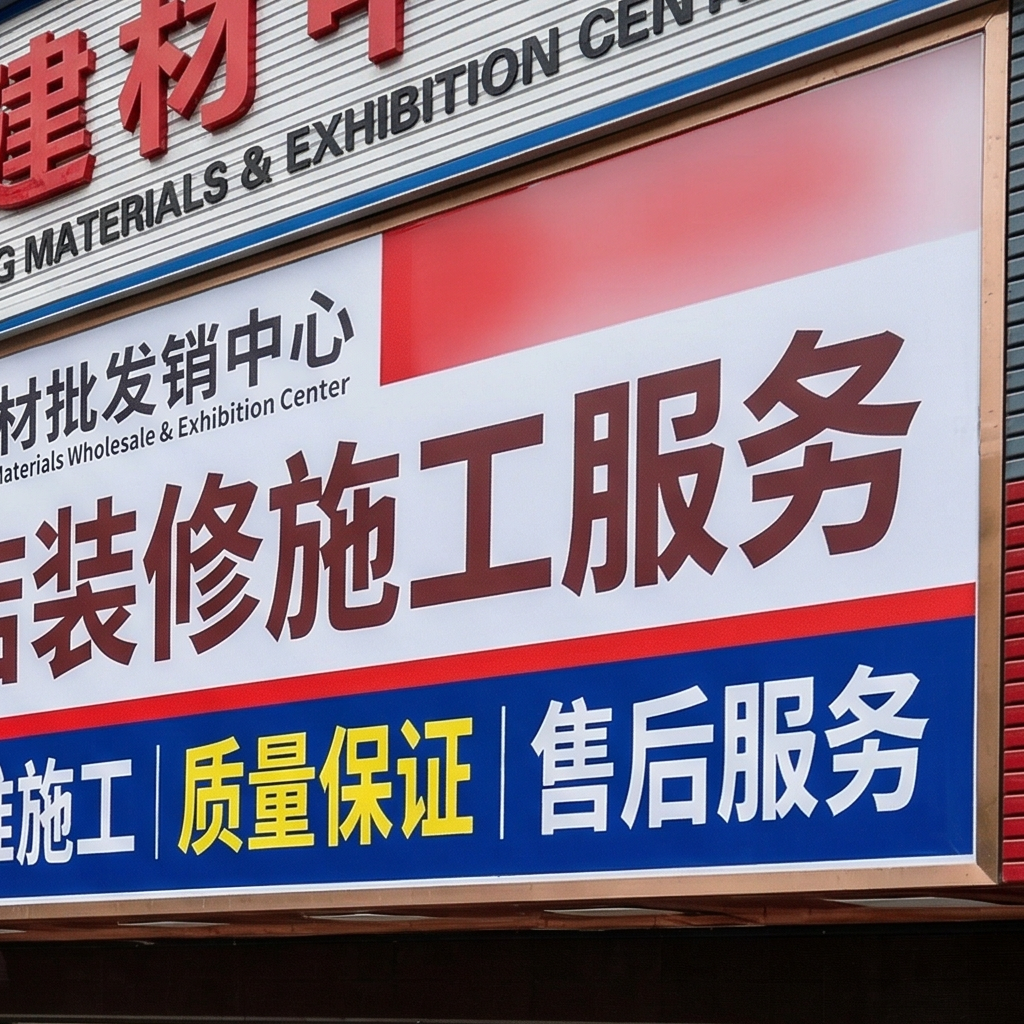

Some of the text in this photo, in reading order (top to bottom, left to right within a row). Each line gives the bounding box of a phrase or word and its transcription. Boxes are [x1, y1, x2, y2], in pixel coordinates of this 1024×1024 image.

[25, 161, 228, 274] MATERIALS
[241, 145, 272, 189] &
[287, 26, 560, 174] EXHIBITION
[579, 0, 748, 58] CEN
[68, 426, 156, 466] Wholesale
[160, 421, 173, 442] &
[178, 396, 275, 438] Exhibition
[280, 376, 351, 410] Center
[177, 717, 474, 857] 质量保证
[530, 664, 930, 836] 售后服务
